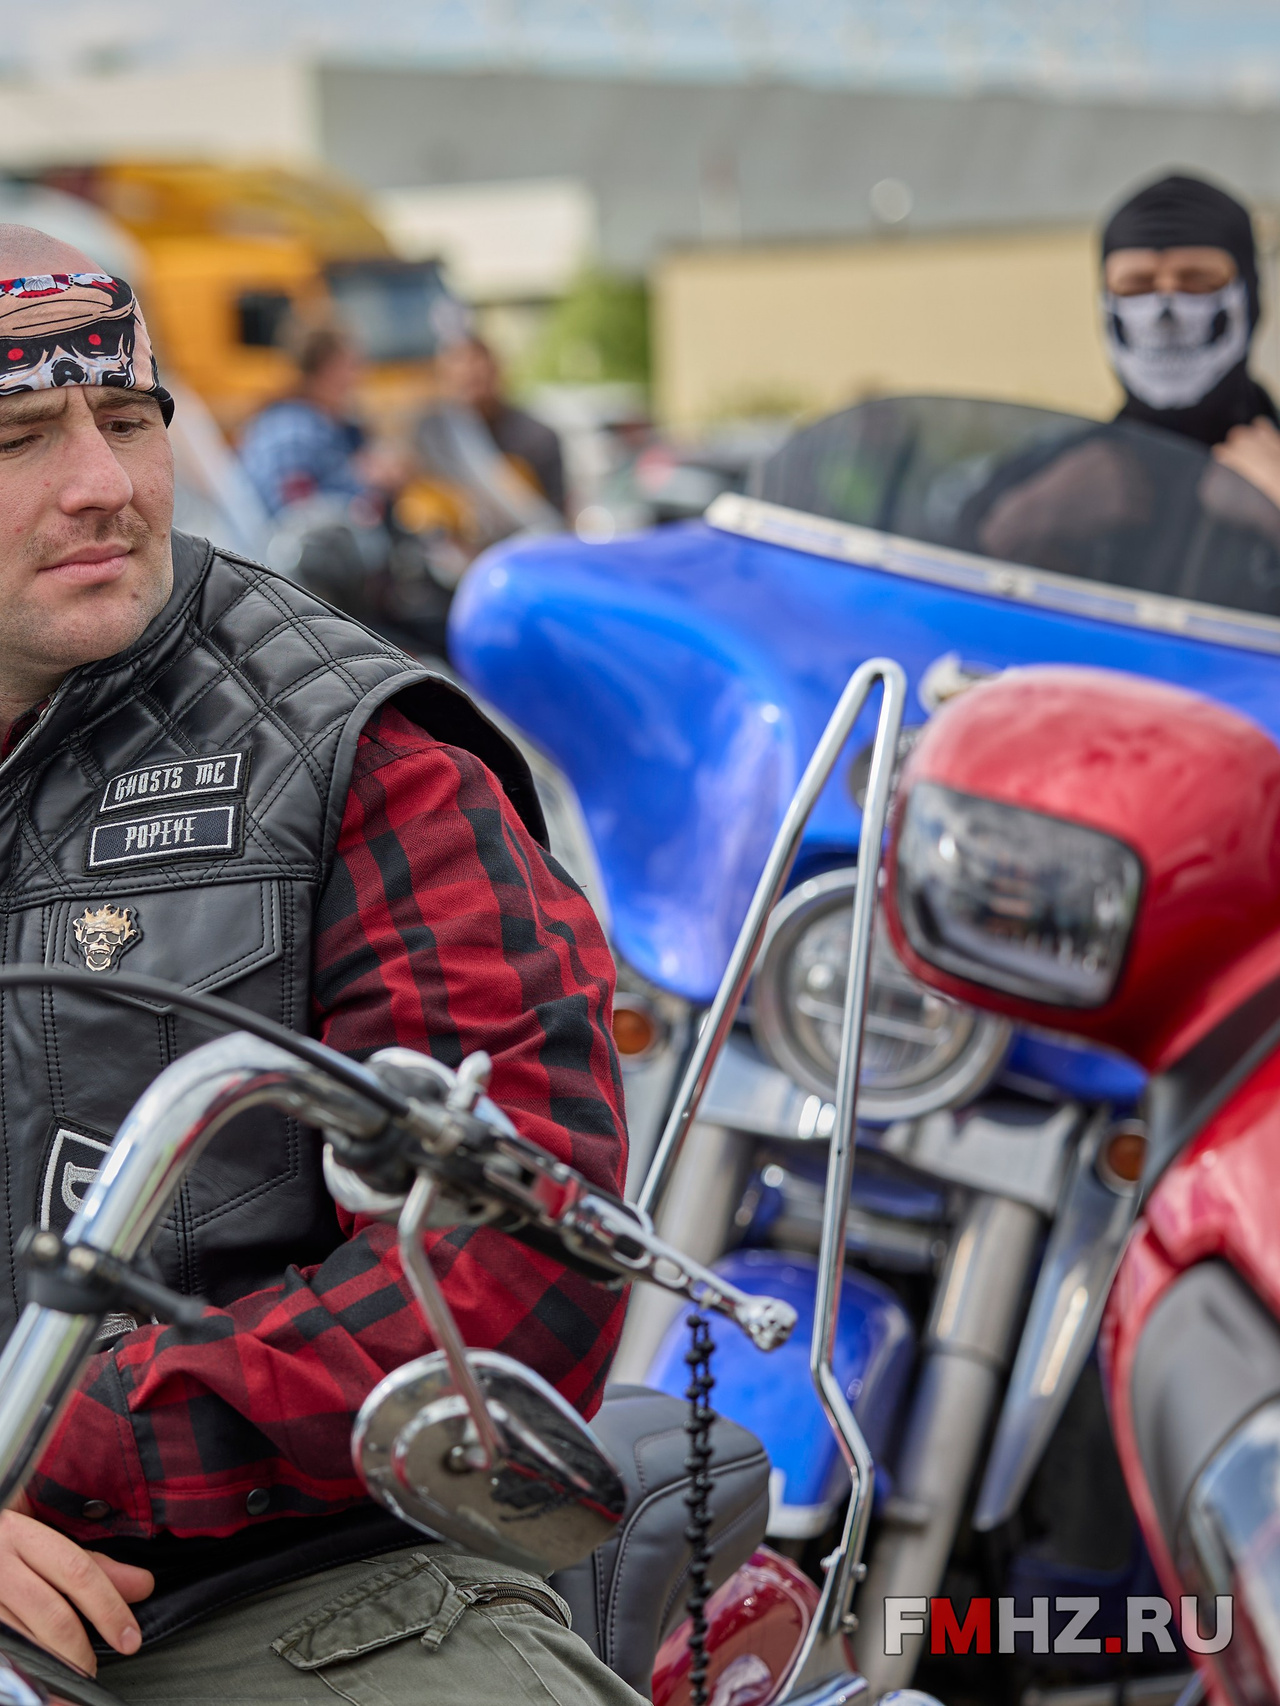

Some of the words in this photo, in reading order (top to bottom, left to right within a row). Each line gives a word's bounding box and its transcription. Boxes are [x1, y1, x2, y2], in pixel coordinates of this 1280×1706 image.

[114, 766, 184, 802] GHOSTS
[195, 760, 227, 786] MC
[124, 816, 198, 852] POPEYE
